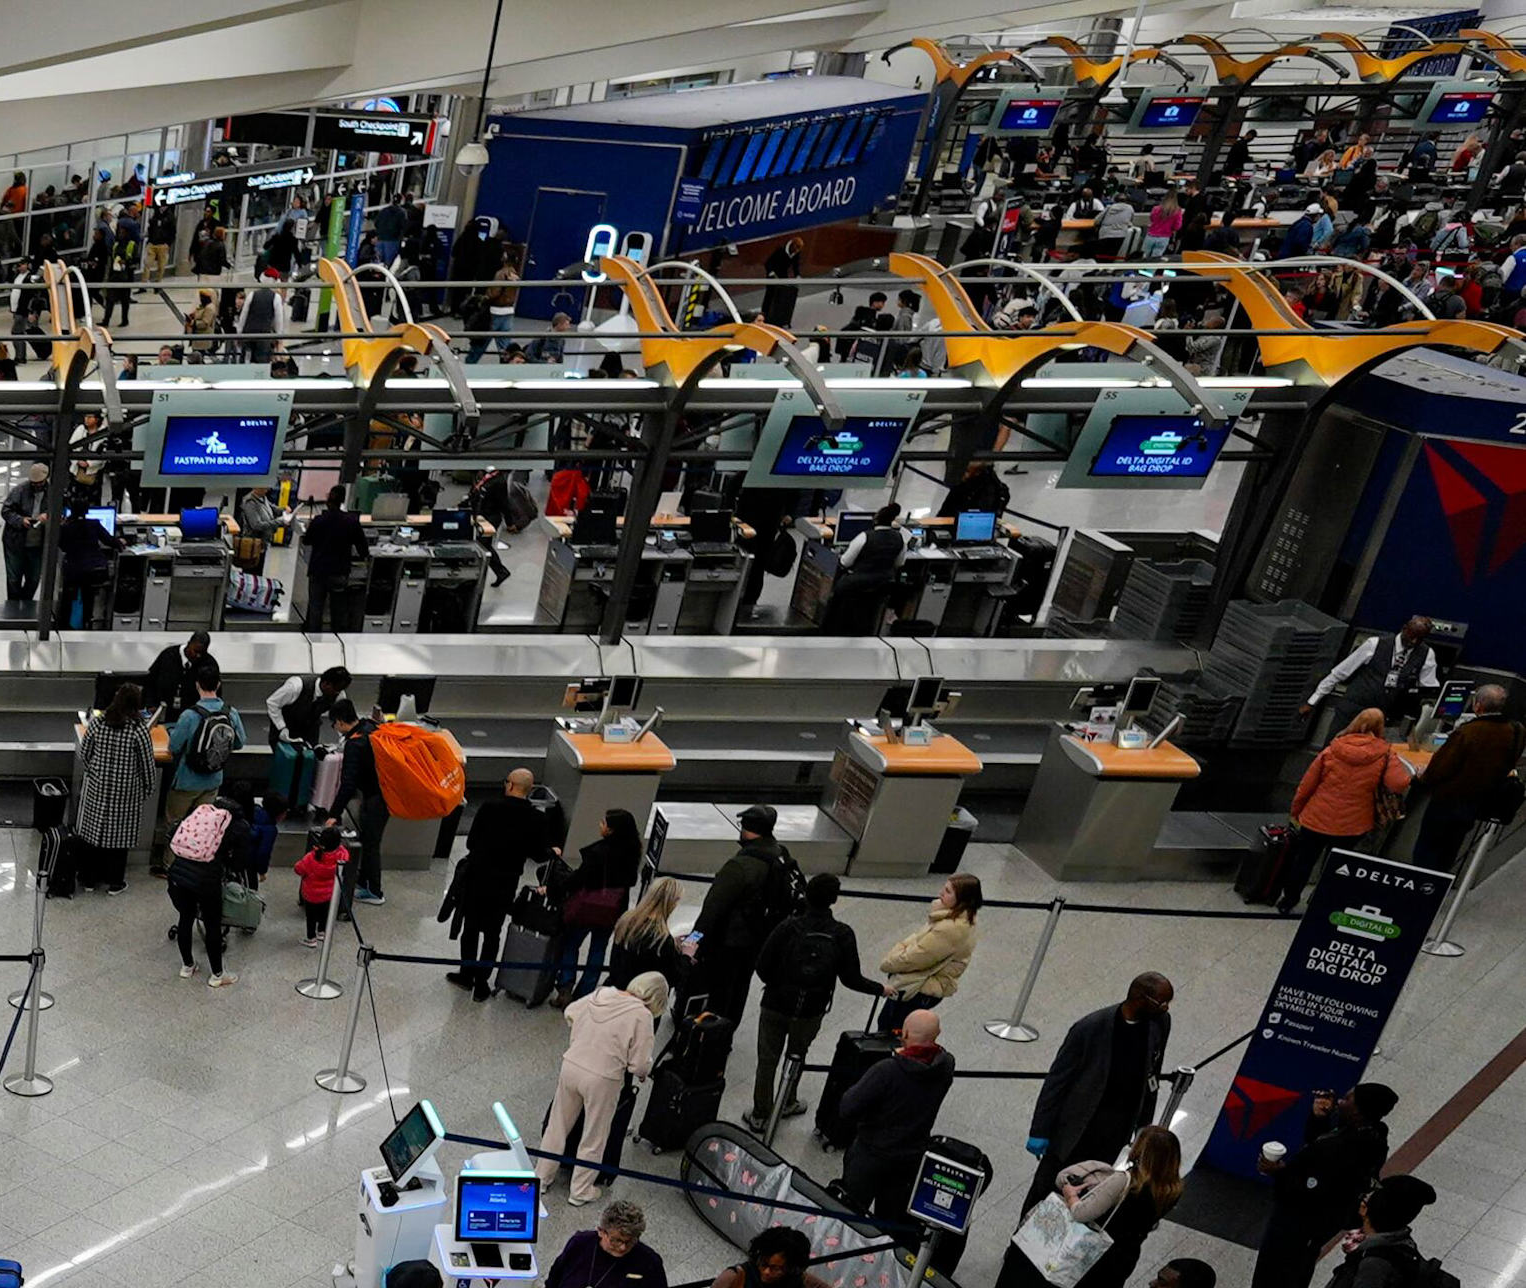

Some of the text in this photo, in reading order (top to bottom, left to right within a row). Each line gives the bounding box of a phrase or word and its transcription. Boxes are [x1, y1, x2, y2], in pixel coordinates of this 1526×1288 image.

[782, 176, 856, 219] ABOARD
[158, 394, 169, 402] 51
[277, 393, 290, 401] 52
[780, 392, 794, 401] 53
[906, 393, 920, 401] 54
[1104, 391, 1119, 400] 55
[1232, 392, 1247, 401] 56
[174, 456, 259, 465] FASTPATH BAG DROP
[797, 456, 824, 465] DELTA
[825, 457, 861, 466] DIGITAL
[1116, 456, 1192, 466] DELTA DIGITAL ID
[809, 464, 852, 472] BAG DROP
[1128, 464, 1174, 472] BAG DROP
[1356, 867, 1415, 891] DELTA
[1349, 918, 1383, 933] DIGITAL
[1329, 940, 1376, 962] DELTA
[1309, 947, 1388, 976] DIGITAL ID
[1306, 959, 1382, 986] BAG DROP
[1277, 992, 1345, 1017] SAVED IN YOUR
[1279, 985, 1379, 1018] HAVE THE FOLLOWING
[1284, 1019, 1315, 1032] Passport
[1319, 1012, 1357, 1028] PROFILE:
[1277, 1034, 1360, 1062] Known Traveler Number
[941, 1166, 964, 1178] DELTA
